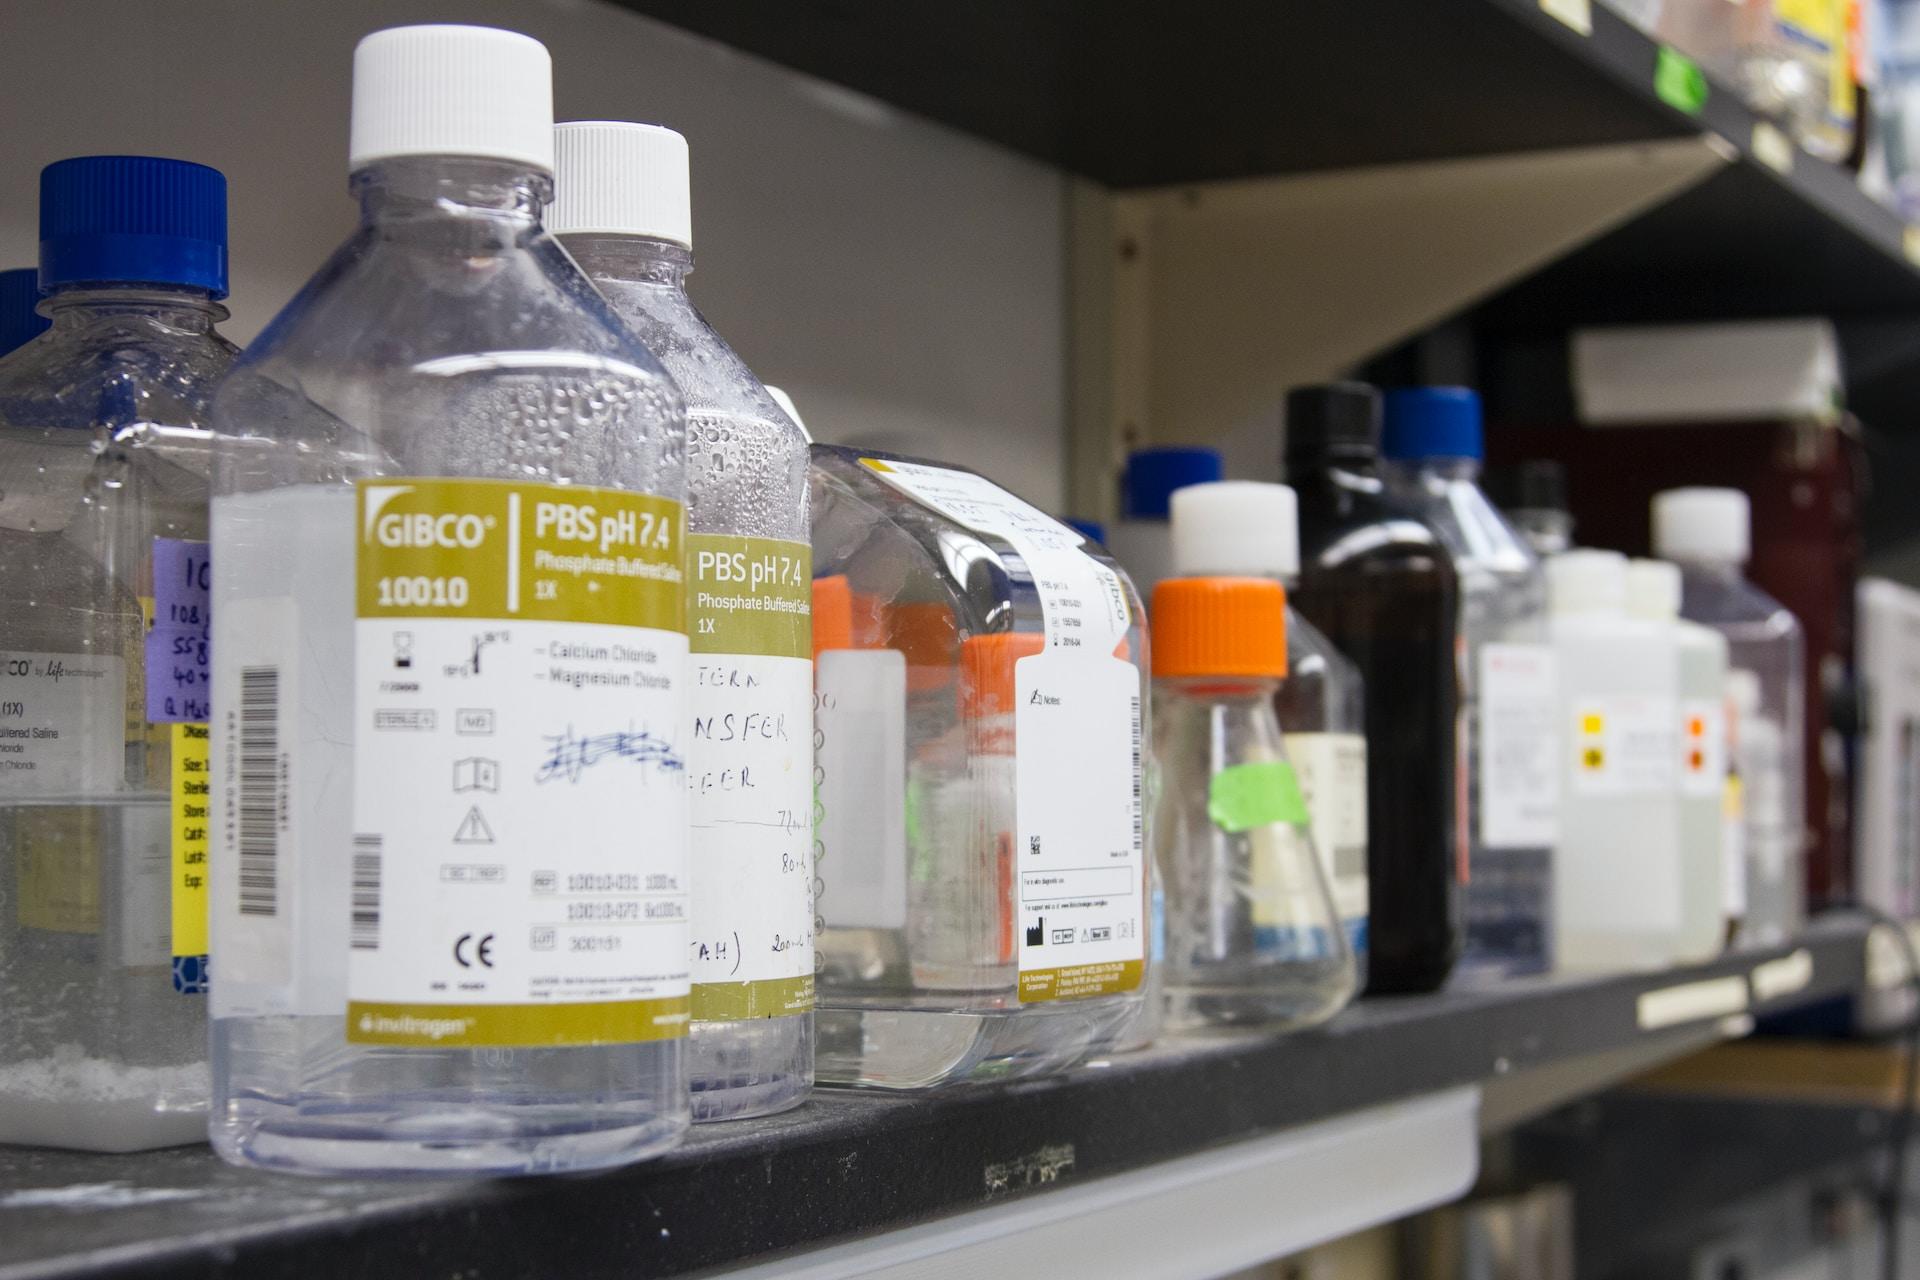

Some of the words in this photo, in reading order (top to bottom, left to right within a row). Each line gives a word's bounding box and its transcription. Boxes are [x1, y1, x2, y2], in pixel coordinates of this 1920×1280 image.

[536, 502, 597, 541] PBS
[600, 510, 636, 552] pH
[640, 512, 670, 549] 7.4
[535, 550, 616, 576] Phosphate
[698, 551, 747, 582] PBS
[751, 555, 777, 593] pH
[781, 557, 802, 588] 7.4
[378, 576, 469, 607] 10010
[1104, 571, 1125, 622] gibco
[171, 604, 199, 624] 108
[698, 592, 762, 614] Phosphate
[763, 596, 796, 613] Buffered
[698, 618, 716, 633] 1X
[549, 640, 608, 660] Calcium
[612, 645, 657, 663] Chloride
[45, 660, 64, 683] life
[549, 669, 630, 688] Magnesium
[2, 701, 24, 718] (1X)
[32, 728, 59, 740] Saline
[4, 760, 36, 770] Chloride
[183, 804, 205, 817] Store
